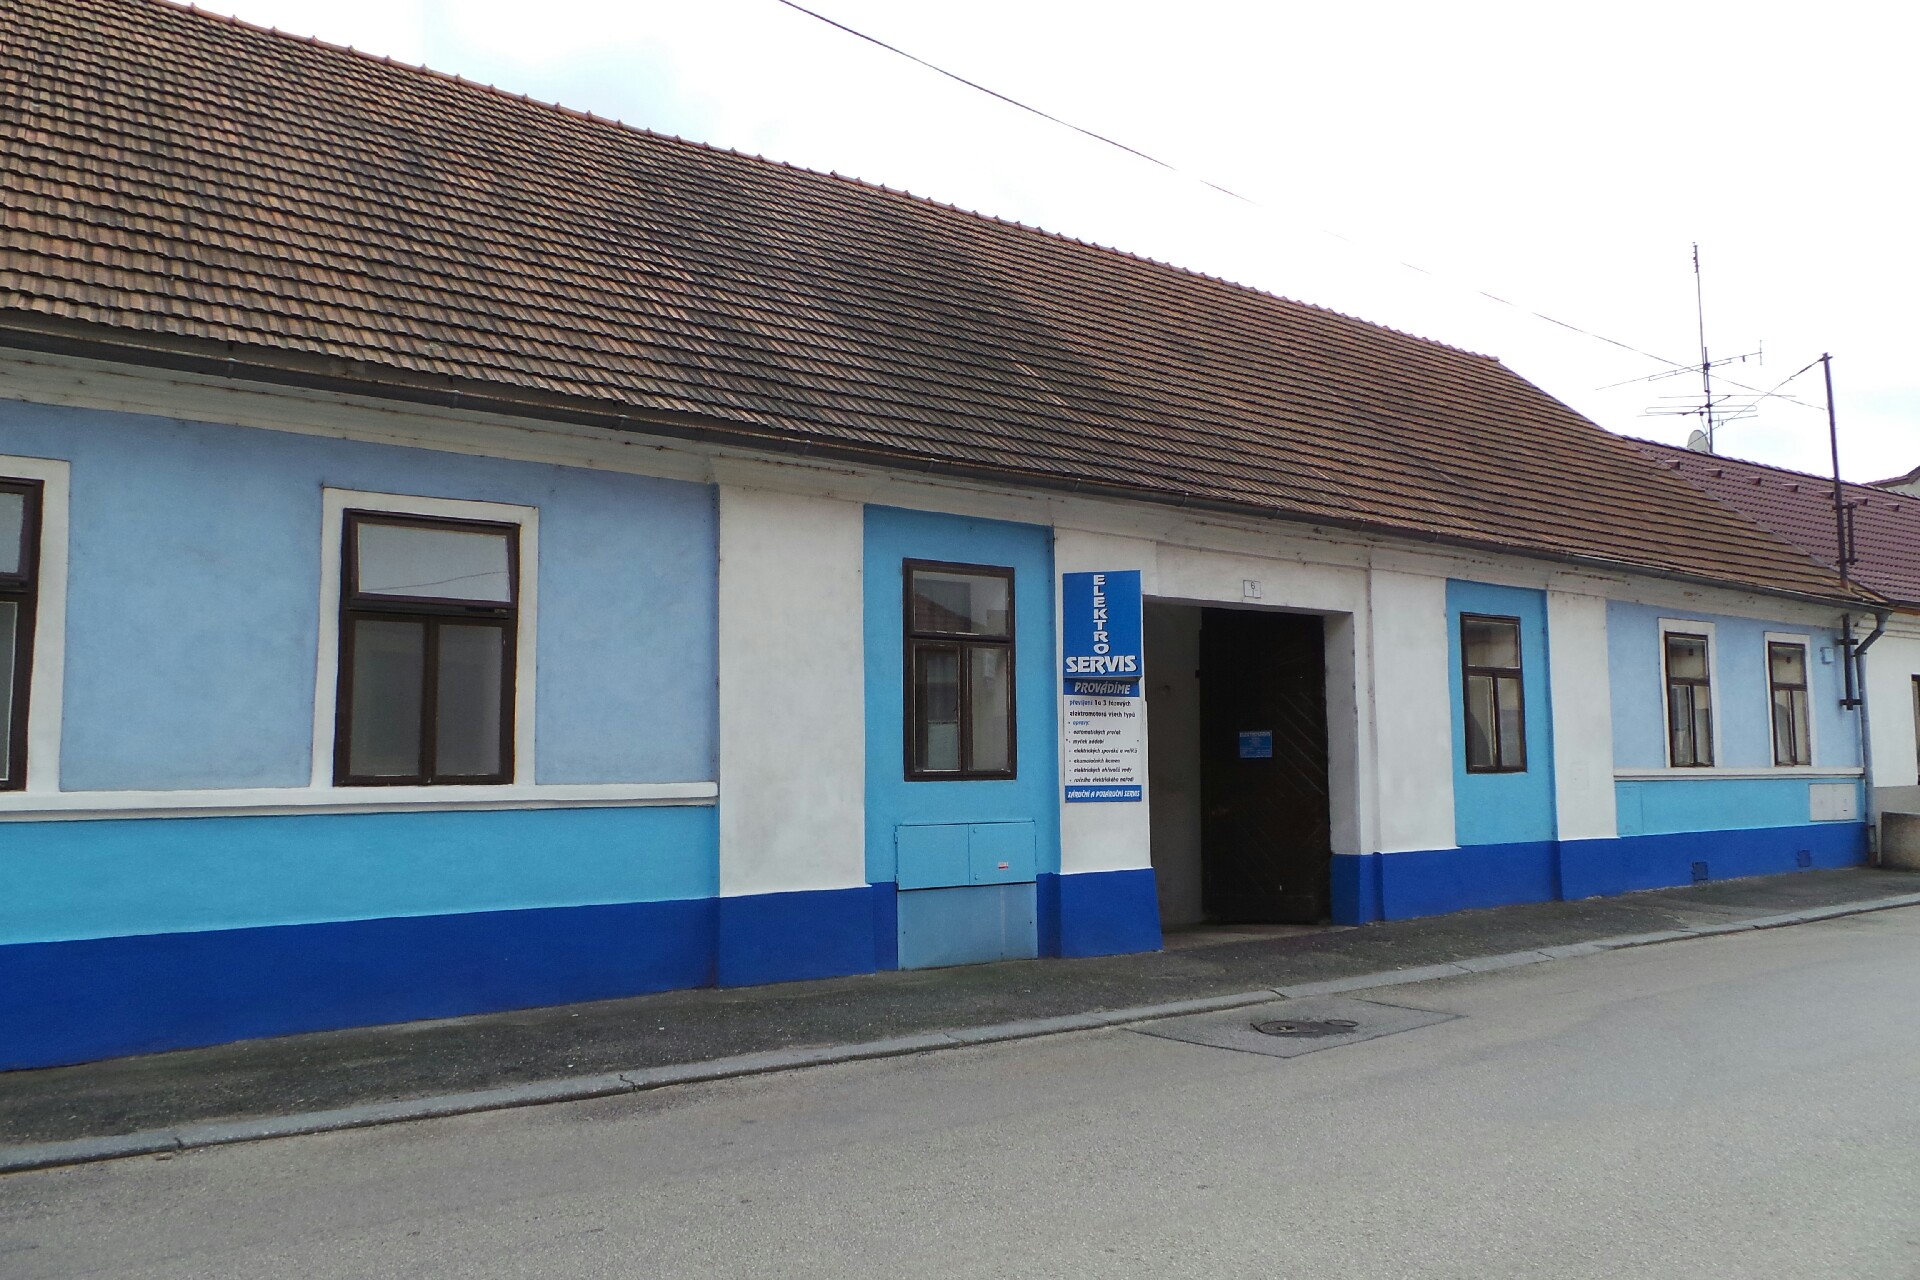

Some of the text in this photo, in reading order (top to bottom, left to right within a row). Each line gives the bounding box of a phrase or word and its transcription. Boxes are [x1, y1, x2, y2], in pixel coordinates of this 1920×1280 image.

[1093, 574, 1110, 654] ELEKTRO
[1065, 655, 1138, 674] SERVIS
[1074, 681, 1131, 695] PROVÁDÍME
